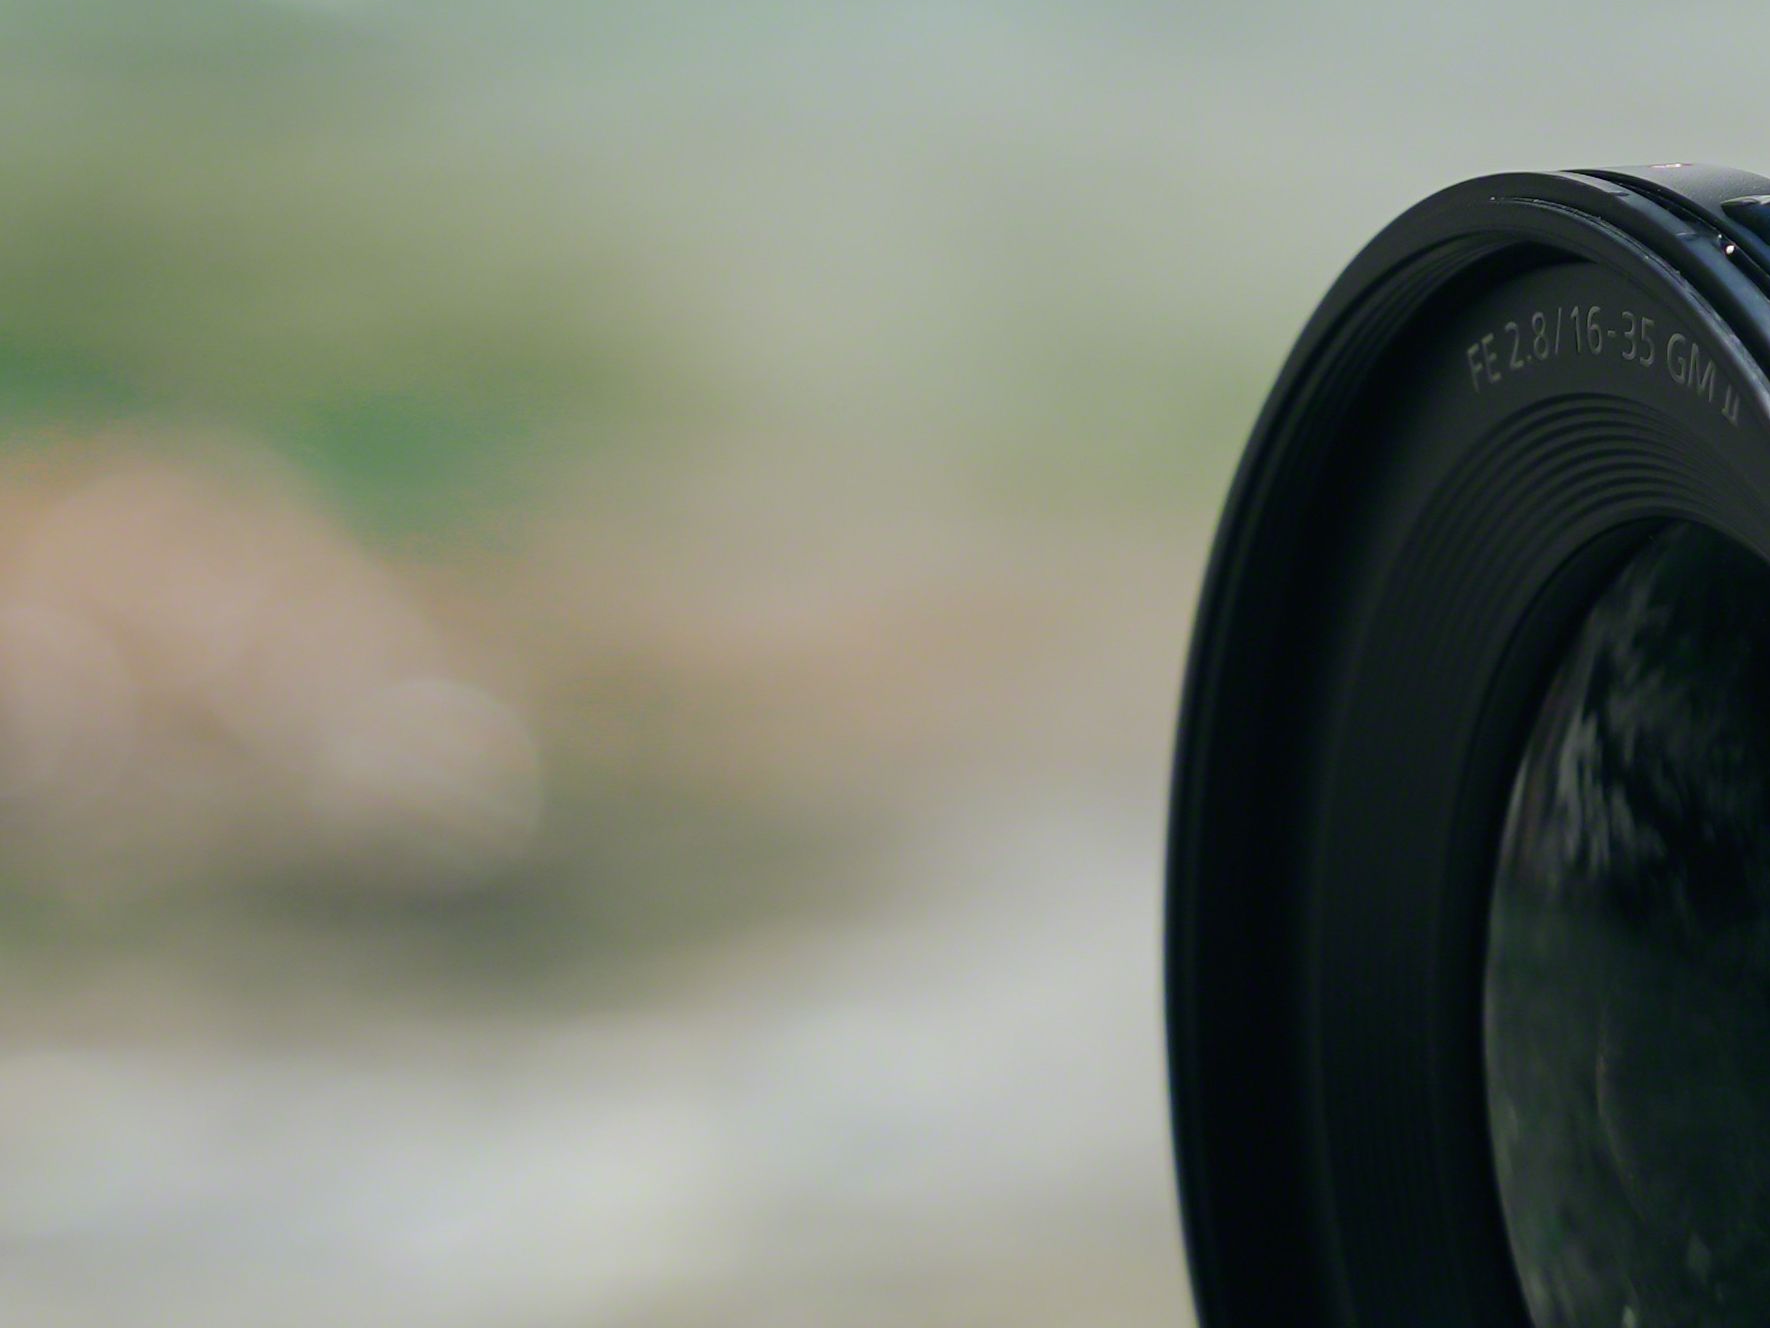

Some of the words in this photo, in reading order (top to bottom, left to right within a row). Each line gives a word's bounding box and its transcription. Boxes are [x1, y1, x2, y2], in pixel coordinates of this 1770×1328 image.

[1466, 332, 1501, 393] FE
[1505, 305, 1656, 370] 2.8/16-35
[1666, 332, 1717, 403] GM
